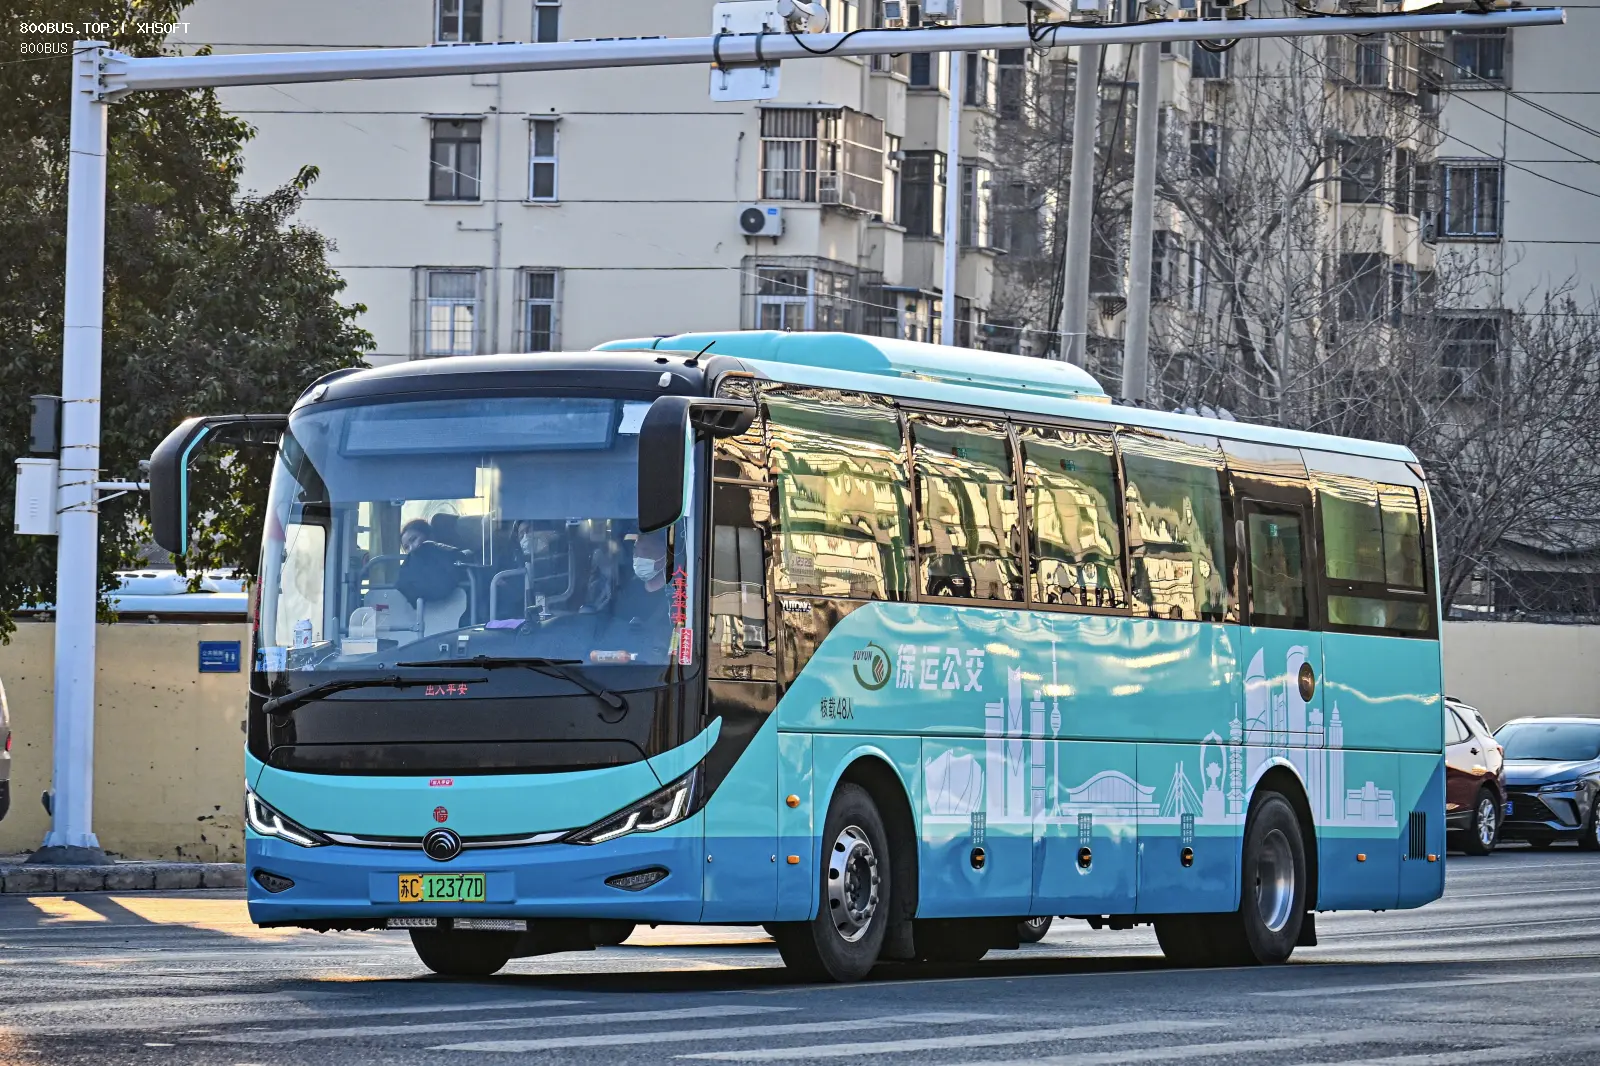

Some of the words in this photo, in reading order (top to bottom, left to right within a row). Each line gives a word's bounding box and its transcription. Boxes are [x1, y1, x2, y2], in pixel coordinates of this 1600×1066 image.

[852, 650, 873, 661] XUYUN
[895, 643, 986, 692] 徐运公交
[425, 682, 468, 696] 出入平安
[820, 696, 854, 720] 核载48人
[400, 878, 419, 898] 苏C
[428, 878, 483, 898] 12377D
